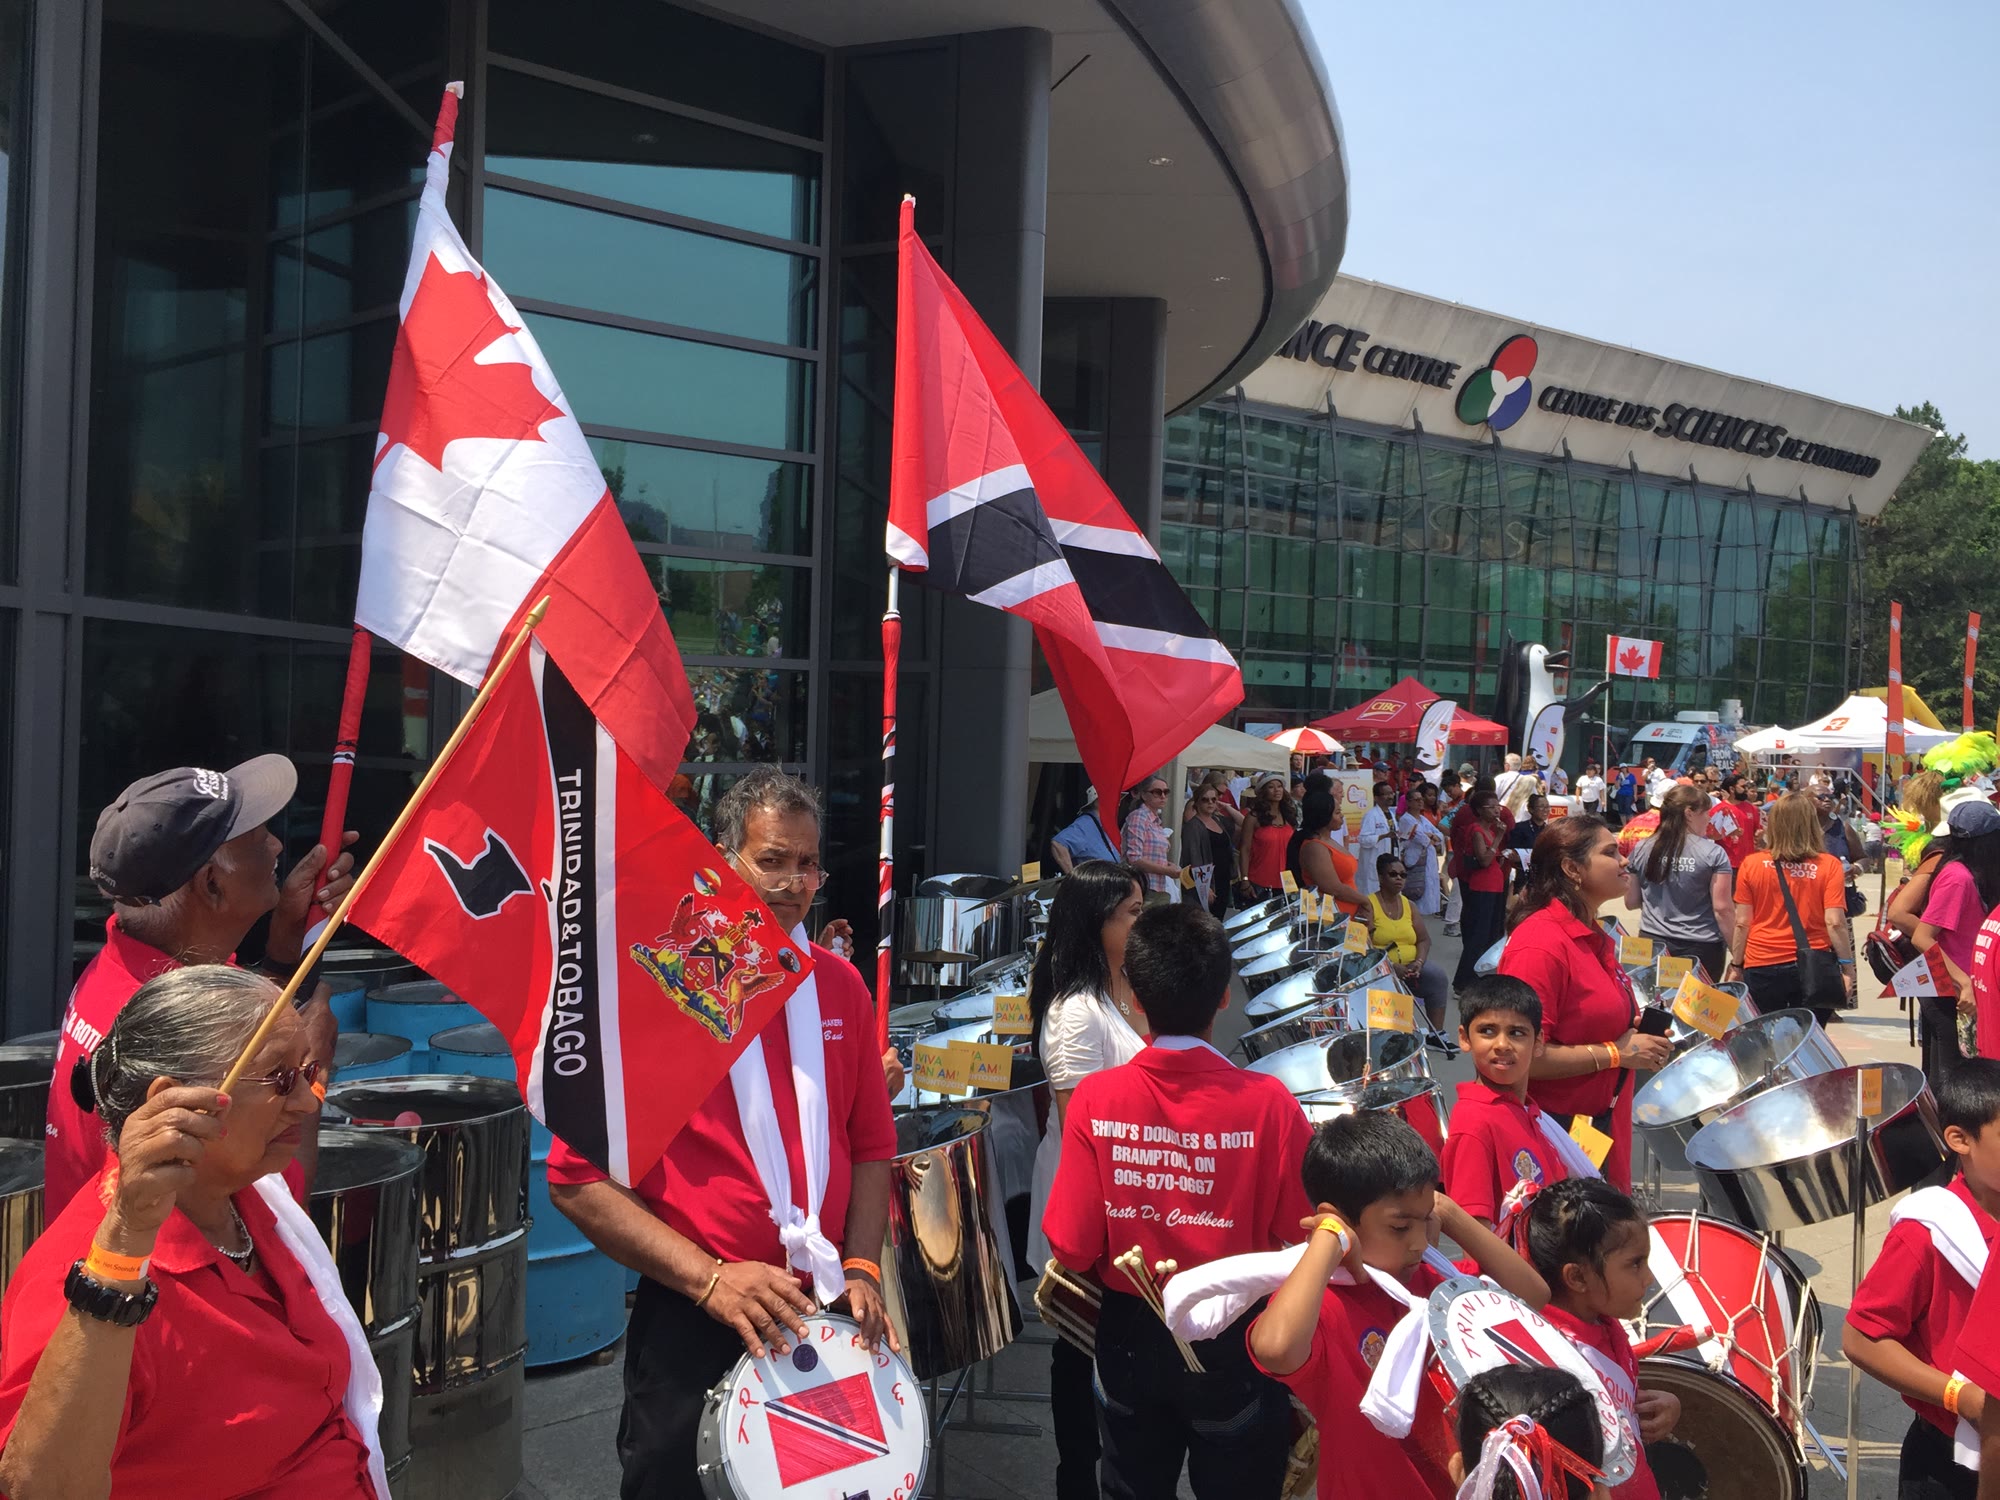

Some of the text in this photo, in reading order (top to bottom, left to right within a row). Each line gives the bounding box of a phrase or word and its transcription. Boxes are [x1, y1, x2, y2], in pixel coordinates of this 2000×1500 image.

[1363, 345, 1461, 390] CENTRE
[1538, 385, 1622, 424] CENTRE
[1614, 401, 1661, 431] DES
[1653, 403, 1788, 459] SCIENCES
[1777, 436, 1808, 461] DE
[1371, 701, 1401, 713] CIBC
[1711, 749, 1731, 760] FROM
[1550, 806, 1567, 816] CIBC
[1672, 864, 1696, 873] 2015
[1790, 869, 1817, 880] 2015
[914, 1063, 935, 1078] PAN
[1203, 1132, 1217, 1151] &
[1220, 1130, 1255, 1149] ROTI
[1112, 1145, 1216, 1173] BRAMPTON, ON
[1113, 1168, 1214, 1195] 905-970-0667
[1140, 1204, 1161, 1221] De
[1165, 1208, 1235, 1229] Caribbean
[1457, 1292, 1545, 1360] TRINIDAD
